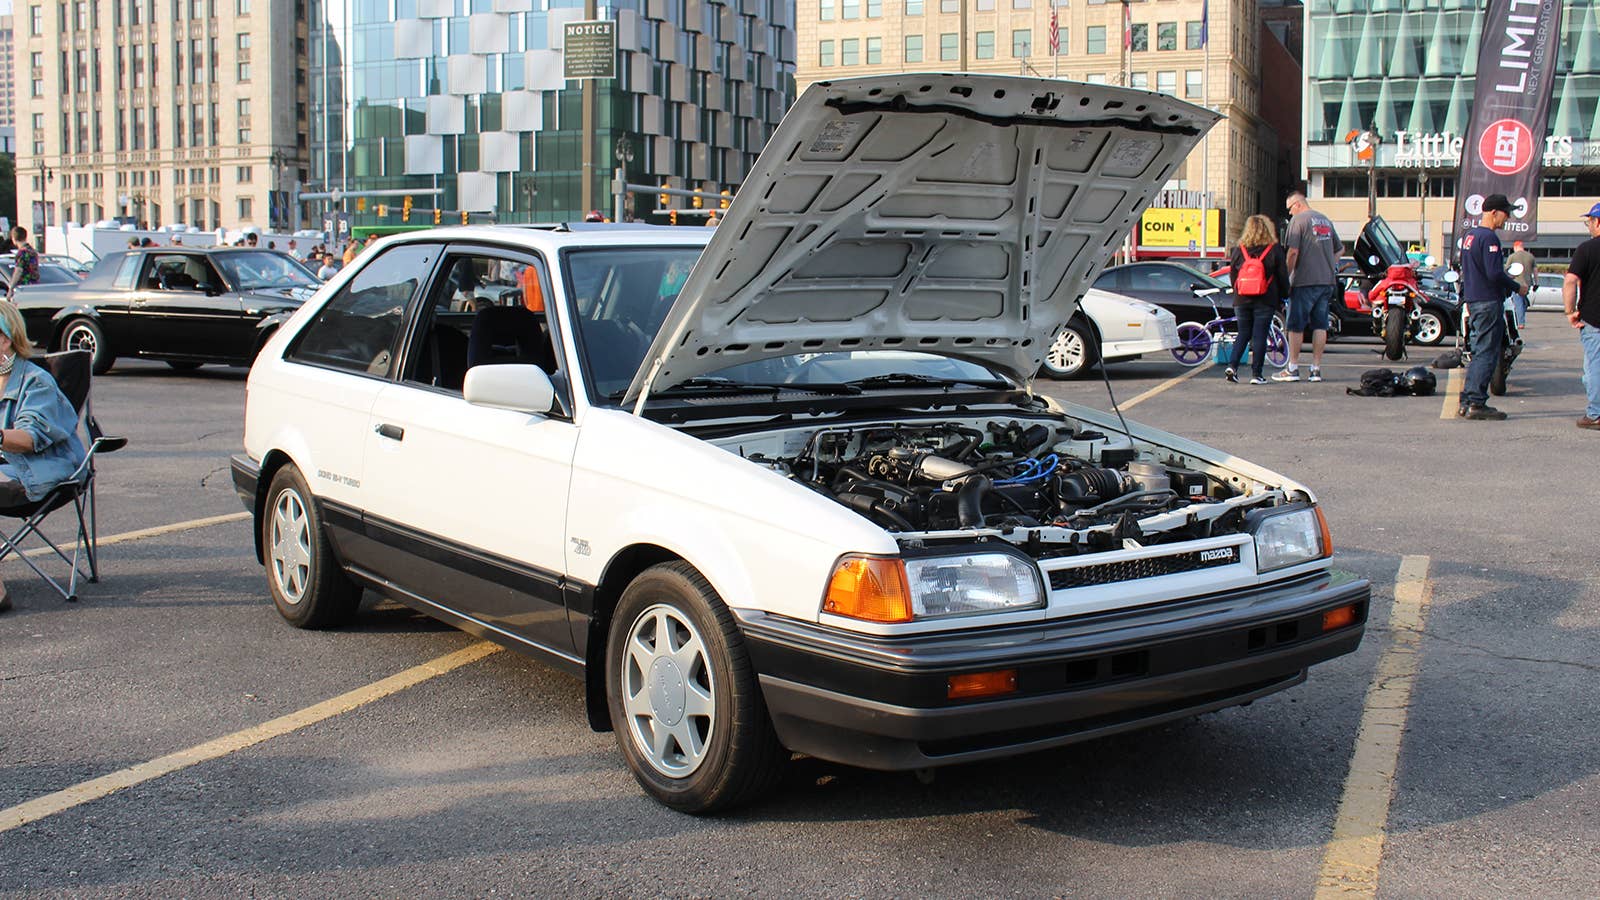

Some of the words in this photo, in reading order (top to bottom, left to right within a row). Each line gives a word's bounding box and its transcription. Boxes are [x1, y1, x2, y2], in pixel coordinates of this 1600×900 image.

[567, 25, 609, 35] NOTICE
[1527, 67, 1538, 95] NEXT
[1533, 0, 1553, 64] GENERATIO
[1395, 130, 1463, 157] Little
[1395, 159, 1441, 168] WORLD
[1149, 190, 1168, 208] HE
[1145, 222, 1174, 231] COIN
[1200, 547, 1233, 561] mazda
